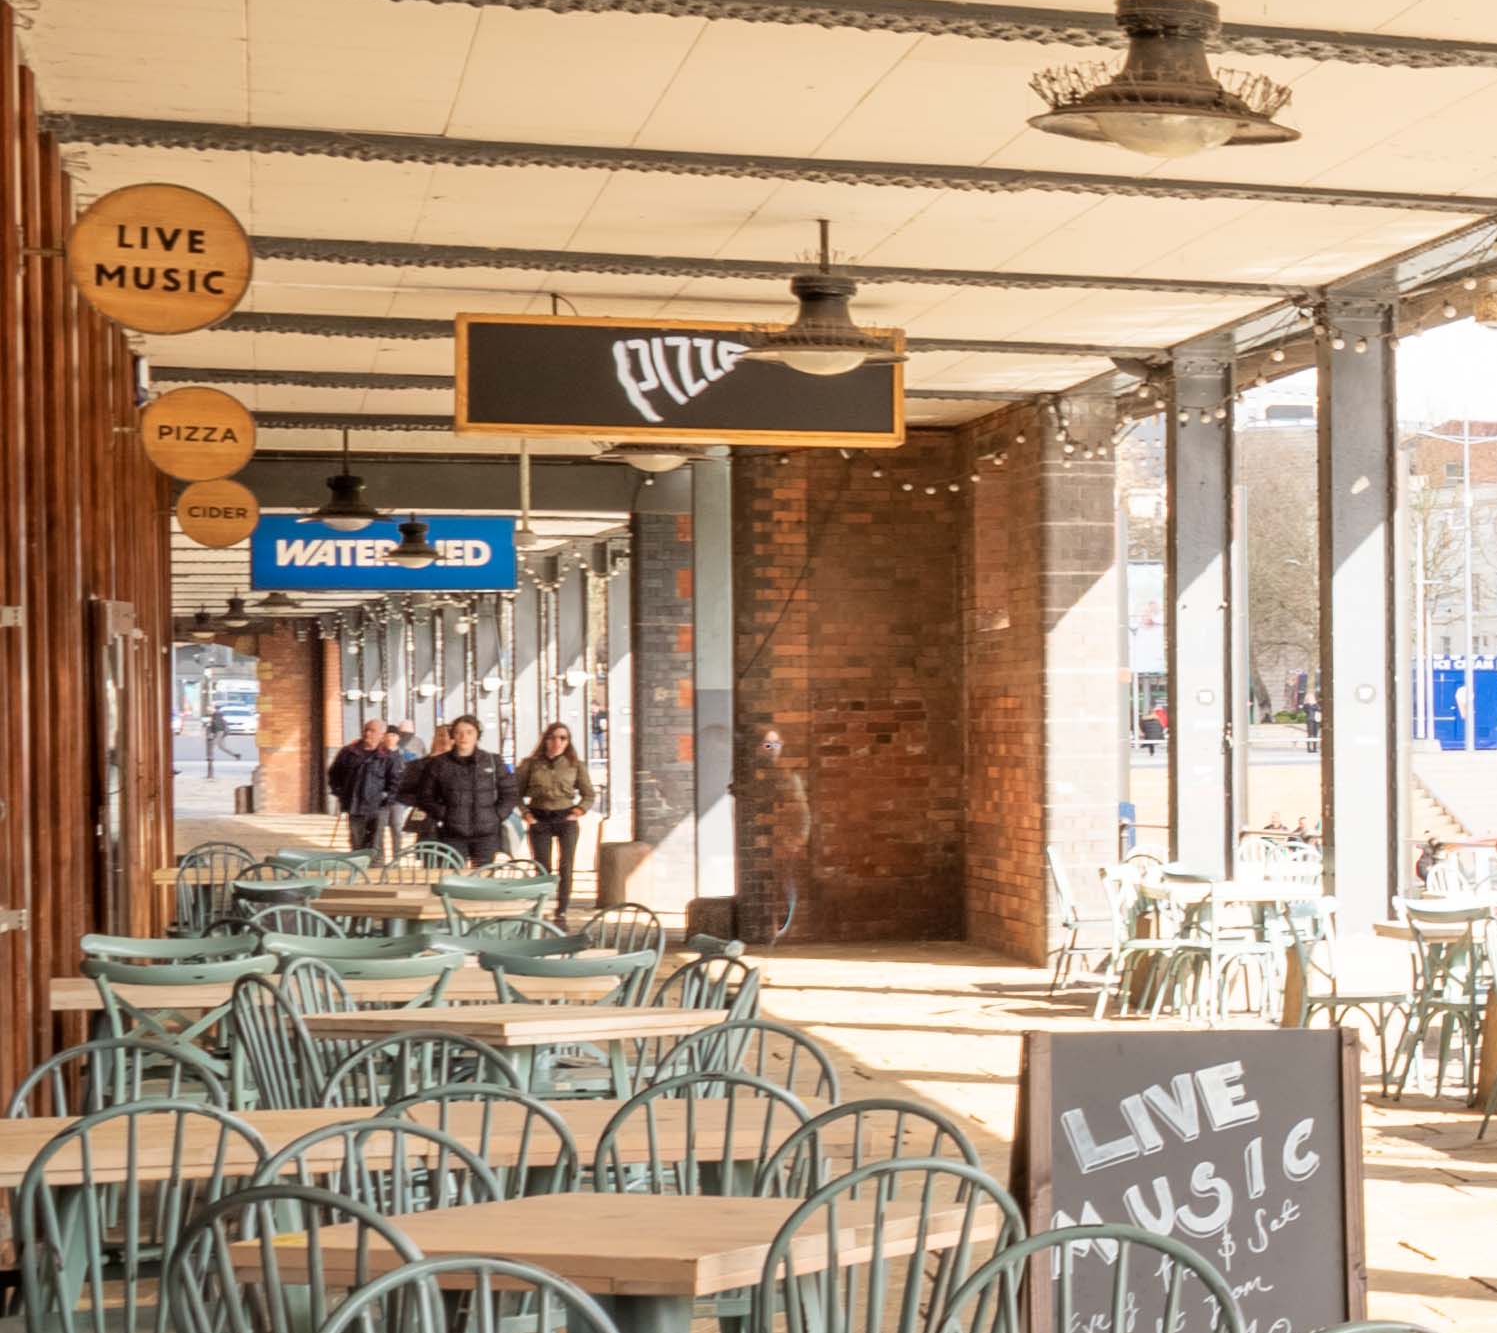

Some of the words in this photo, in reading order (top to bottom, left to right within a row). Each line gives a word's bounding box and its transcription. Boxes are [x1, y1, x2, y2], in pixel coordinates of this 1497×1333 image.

[117, 223, 206, 255] LIVE
[95, 262, 225, 295] MUSIC
[157, 424, 239, 444] PIZZA
[187, 505, 249, 520] CIDER
[1060, 1059, 1261, 1174] LIVE
